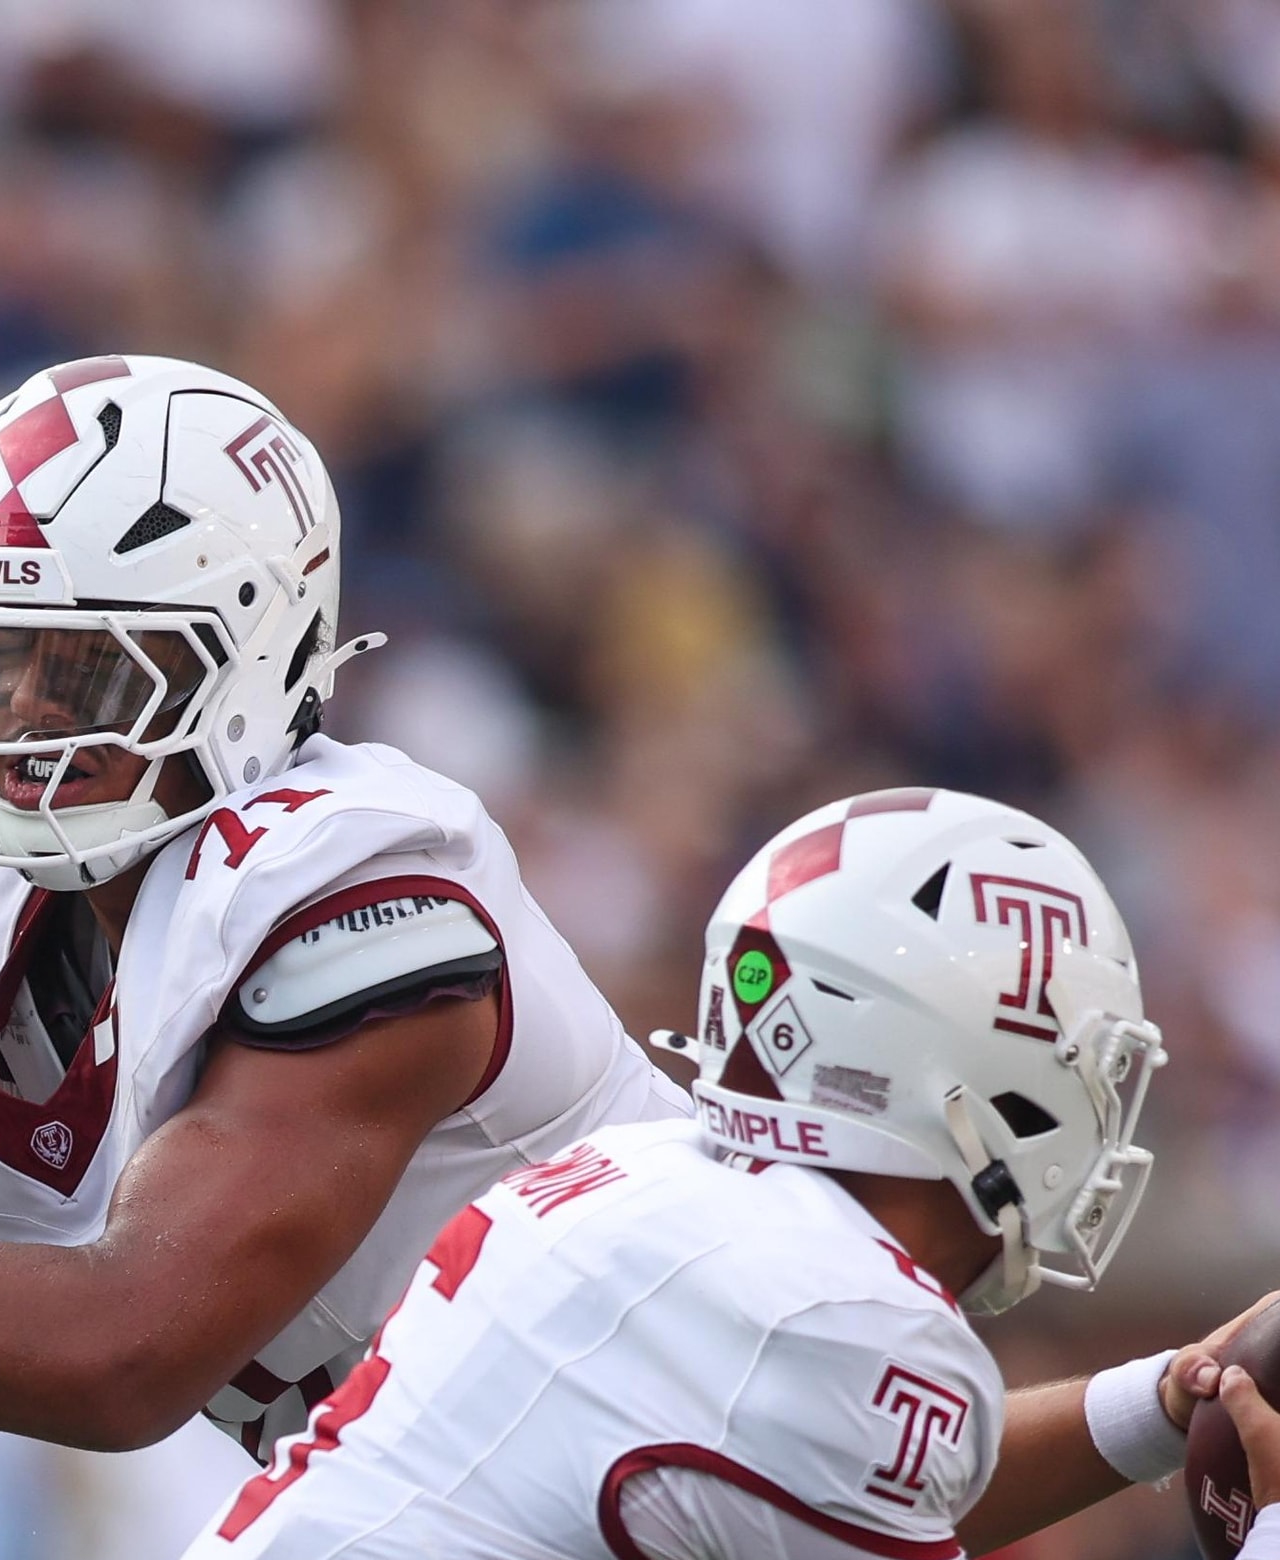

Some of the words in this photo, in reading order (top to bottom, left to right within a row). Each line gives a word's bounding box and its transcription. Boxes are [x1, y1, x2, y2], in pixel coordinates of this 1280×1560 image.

[738, 964, 768, 986] C2P
[969, 872, 1088, 1044] T
[772, 1022, 795, 1052] 6
[696, 1093, 830, 1158] TEMPLE
[865, 1363, 970, 1508] T
